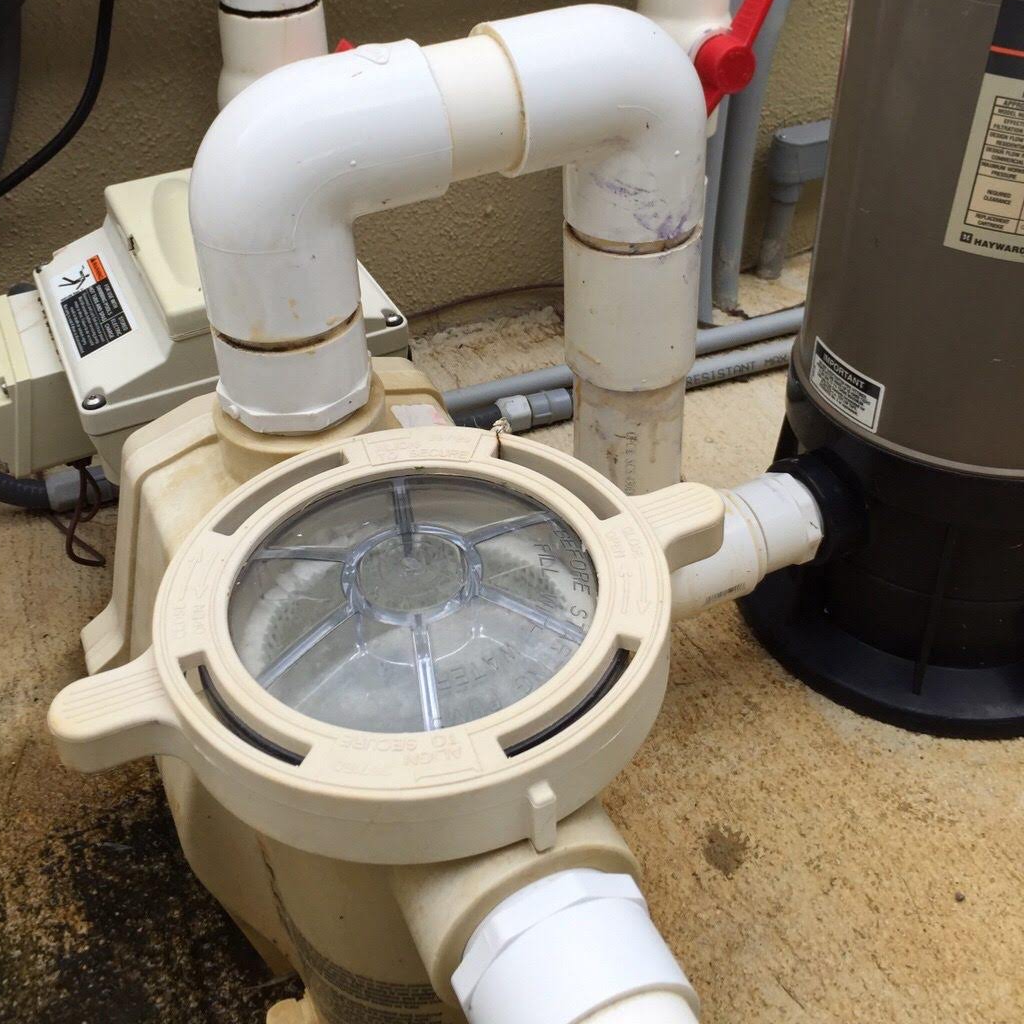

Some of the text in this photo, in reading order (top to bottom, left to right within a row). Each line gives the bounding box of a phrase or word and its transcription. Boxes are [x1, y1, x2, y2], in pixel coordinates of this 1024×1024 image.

[823, 352, 865, 389] IMPORTANT
[534, 543, 560, 578] FILL
[553, 527, 592, 597] BEFORE
